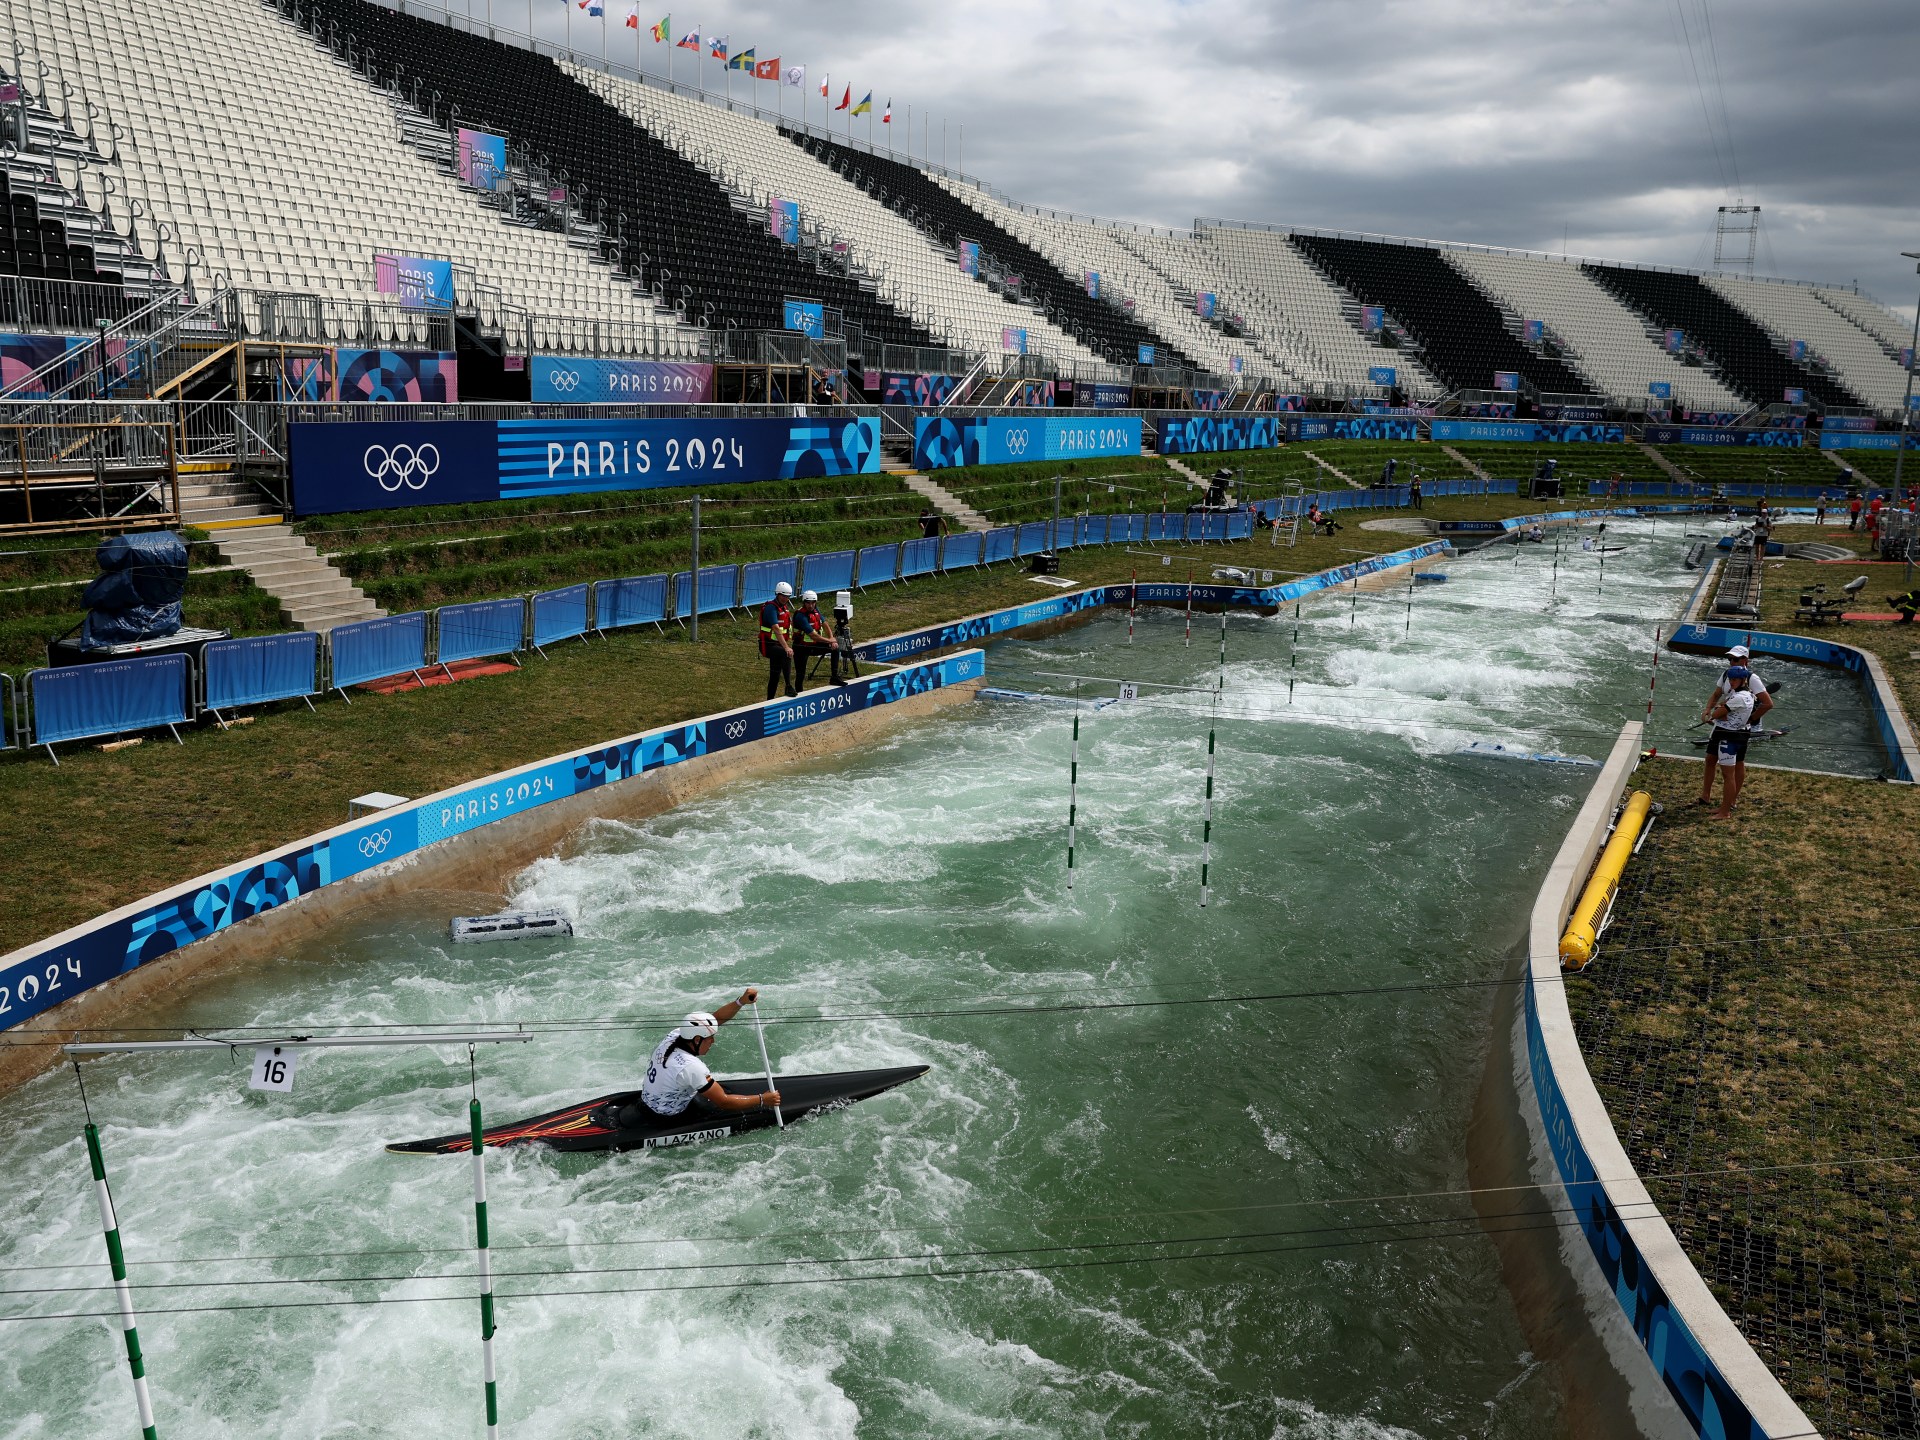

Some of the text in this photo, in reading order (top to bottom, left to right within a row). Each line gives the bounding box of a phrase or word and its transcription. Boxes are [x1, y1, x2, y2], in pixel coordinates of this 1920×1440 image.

[663, 375, 702, 392] 2024
[1115, 393, 1129, 403] 2024
[1100, 429, 1128, 449] 2024
[1500, 428, 1524, 437] 2024
[1715, 434, 1735, 443] 2024
[666, 437, 743, 471] 2024
[1042, 604, 1058, 615] 2024
[910, 635, 931, 649] 2024
[1786, 641, 1818, 655] 2024
[1123, 688, 1133, 699] 18
[820, 692, 851, 714] 2024
[506, 775, 553, 806] 2024
[0, 957, 82, 1015] 2024
[264, 1059, 287, 1084] 16
[646, 1060, 657, 1084] 28
[1552, 1103, 1578, 1187] 2024
